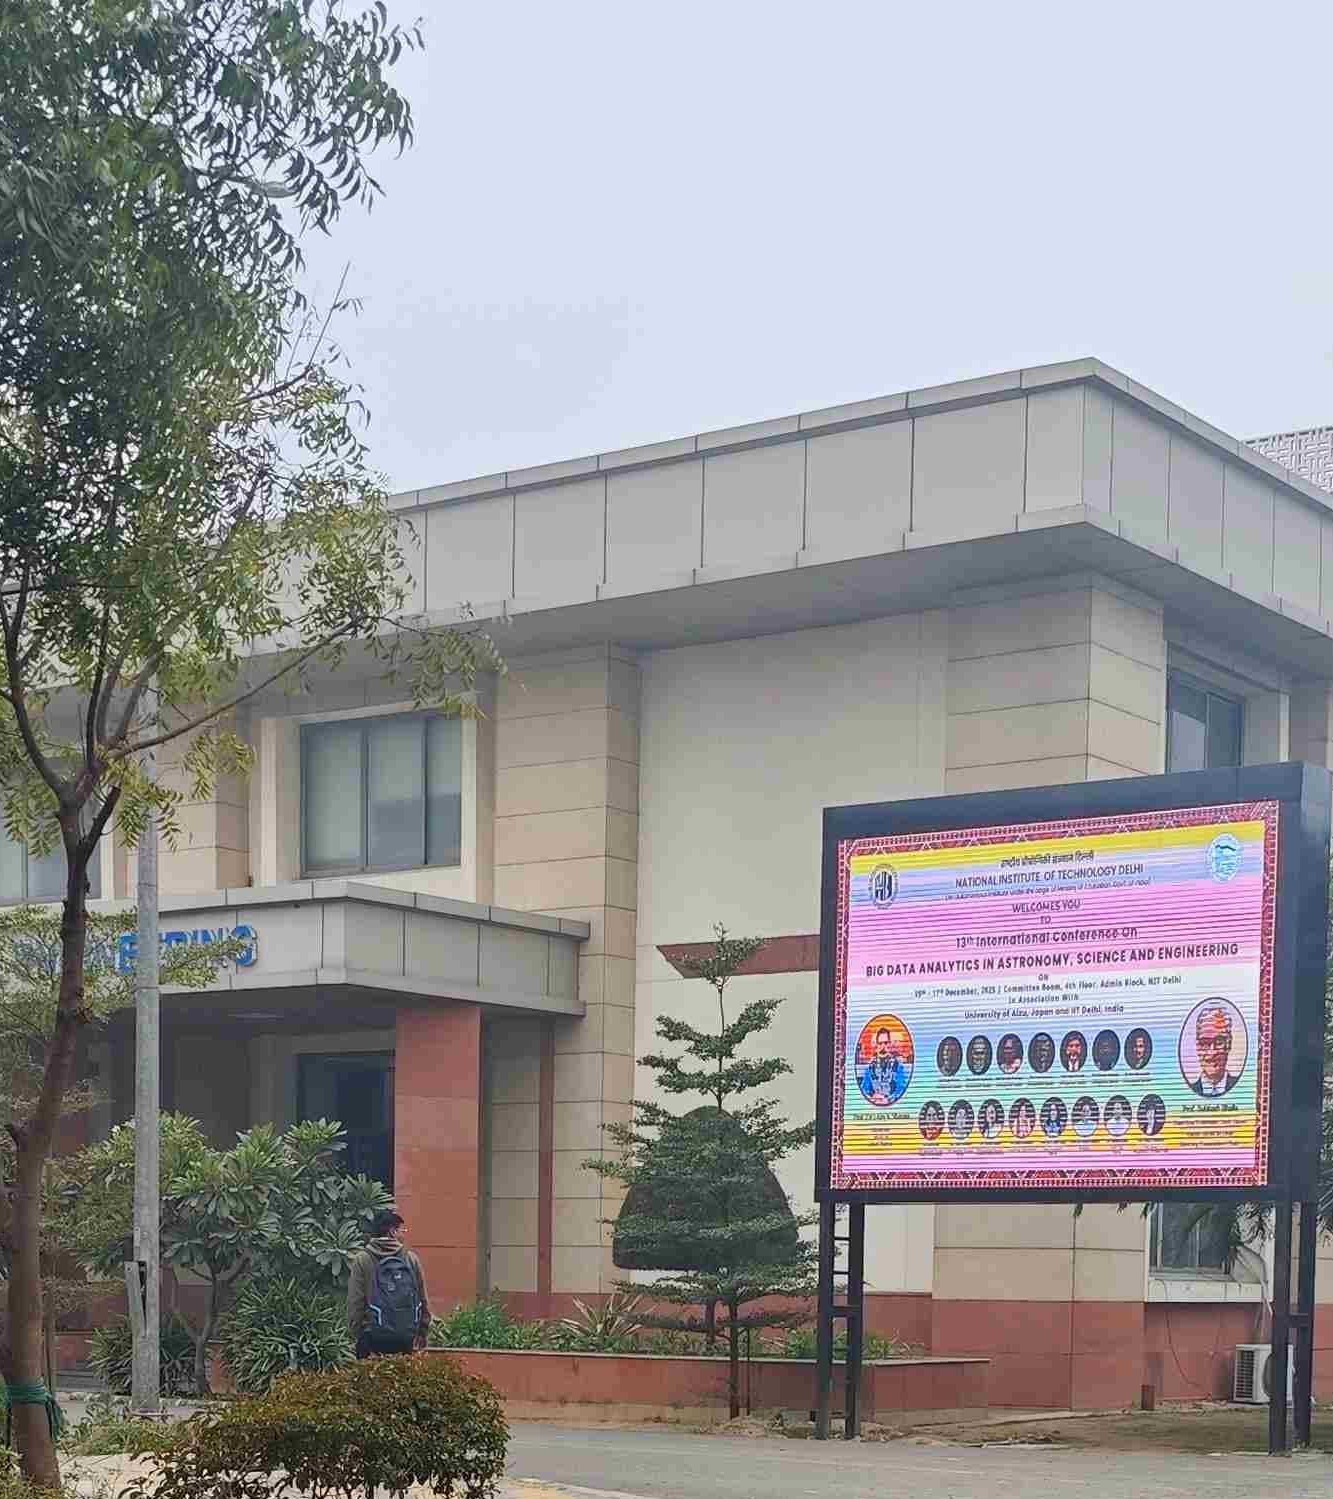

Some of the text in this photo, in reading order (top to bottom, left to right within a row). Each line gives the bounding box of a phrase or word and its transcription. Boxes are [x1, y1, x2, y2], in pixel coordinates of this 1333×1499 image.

[955, 863, 1143, 889] NATIONAL INSTITUTE OF TECHNOLOGY DELHI
[1012, 898, 1081, 914] WELCOMES YOU
[1040, 915, 1052, 925] TO
[976, 931, 1051, 949] International
[1053, 928, 1120, 942] Conference
[866, 943, 1239, 977] BIG DATA ANALYTICS IN ASTRONOMY, SCIENCE AND ENGINEERING
[964, 1008, 1001, 1020] University
[1002, 1007, 1010, 1018] of
[1031, 1006, 1054, 1018] Japan
